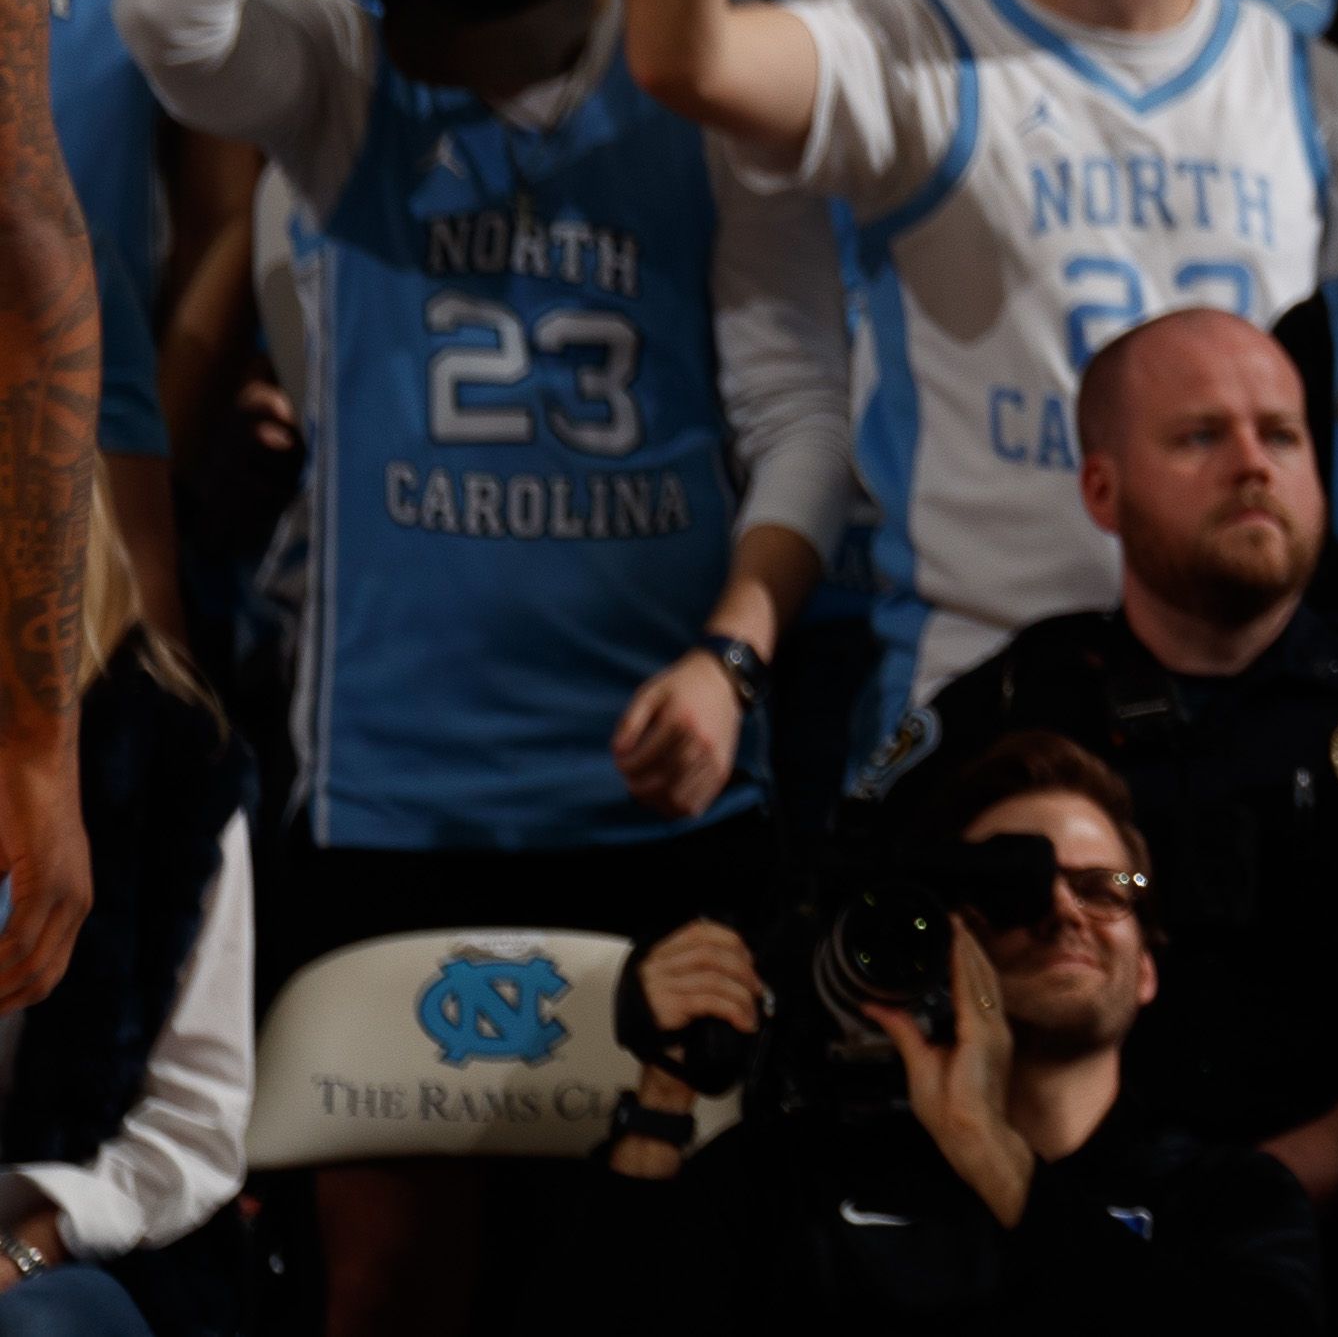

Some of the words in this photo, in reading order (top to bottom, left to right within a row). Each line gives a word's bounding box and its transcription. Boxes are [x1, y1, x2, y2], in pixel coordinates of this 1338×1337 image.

[1030, 153, 1276, 248] NORTH
[427, 212, 639, 299] NORTH
[426, 290, 643, 455] 23
[385, 461, 691, 539] CAROLINA
[316, 1073, 408, 1118] THE
[418, 1076, 540, 1124] RAMS
